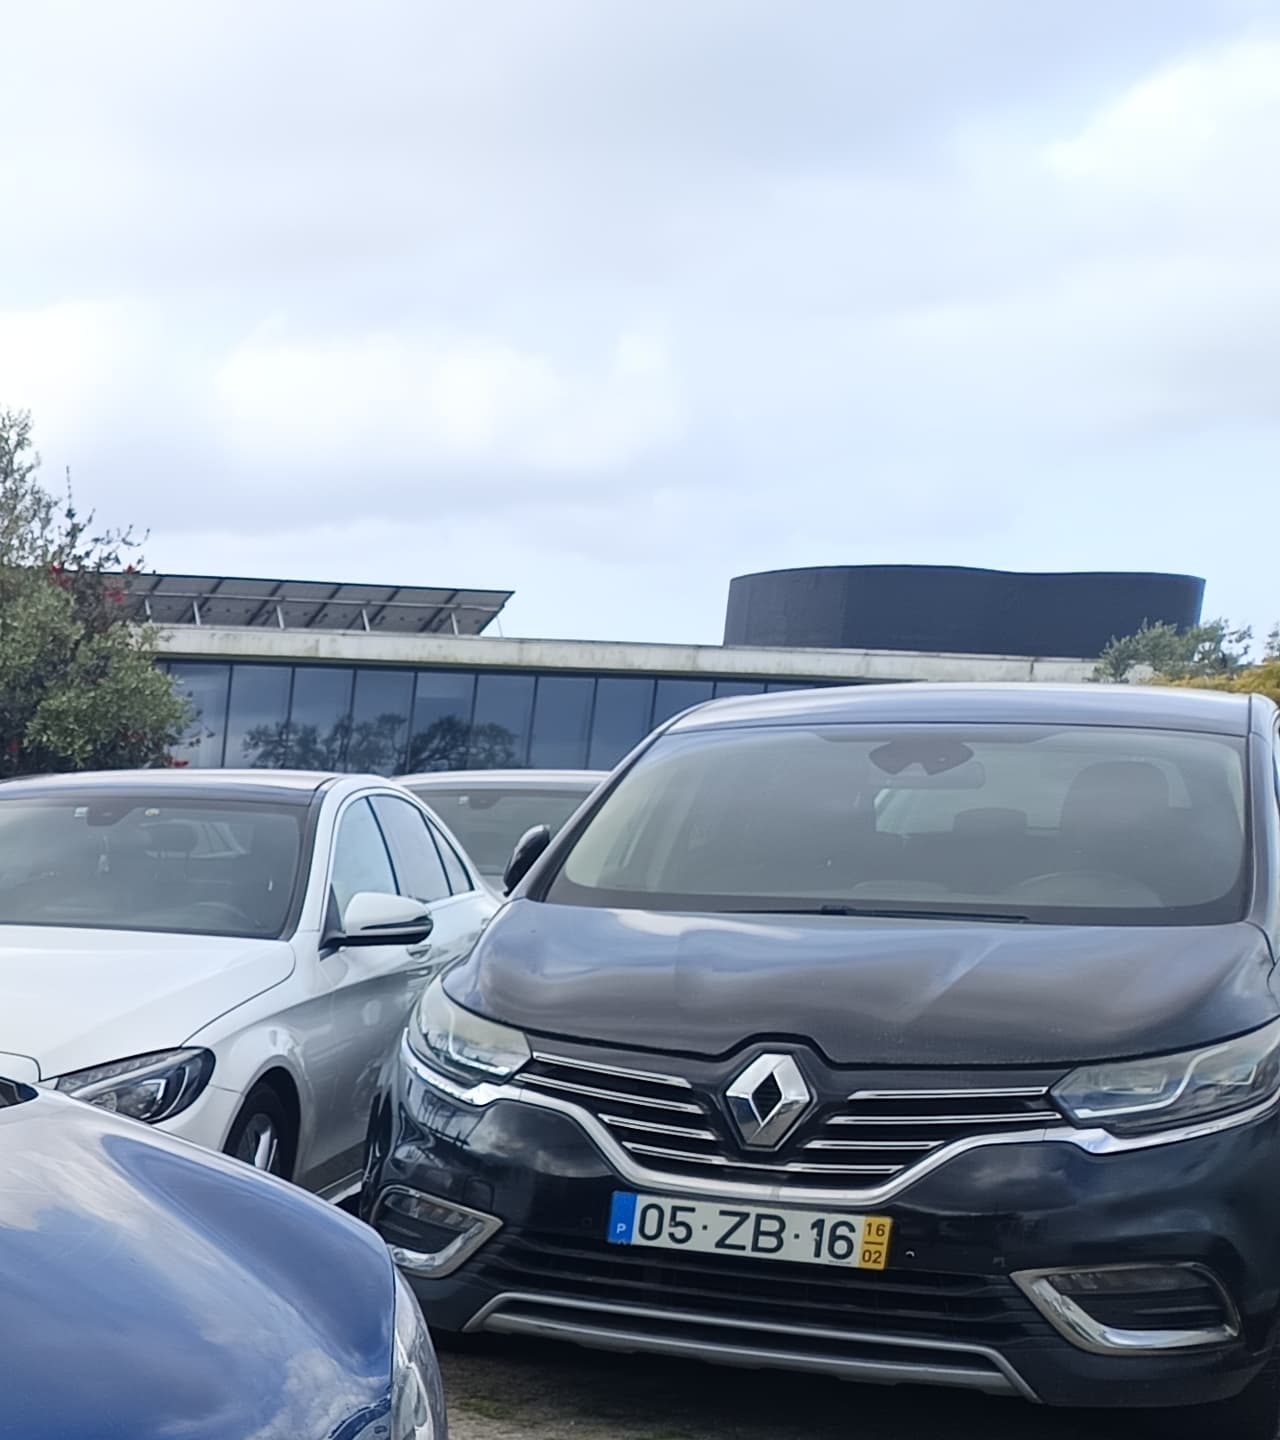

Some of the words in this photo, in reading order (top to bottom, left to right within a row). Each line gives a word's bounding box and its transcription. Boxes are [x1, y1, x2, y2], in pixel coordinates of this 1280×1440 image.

[616, 1223, 627, 1234] P
[866, 1222, 886, 1237] 16
[862, 1249, 882, 1264] 02
